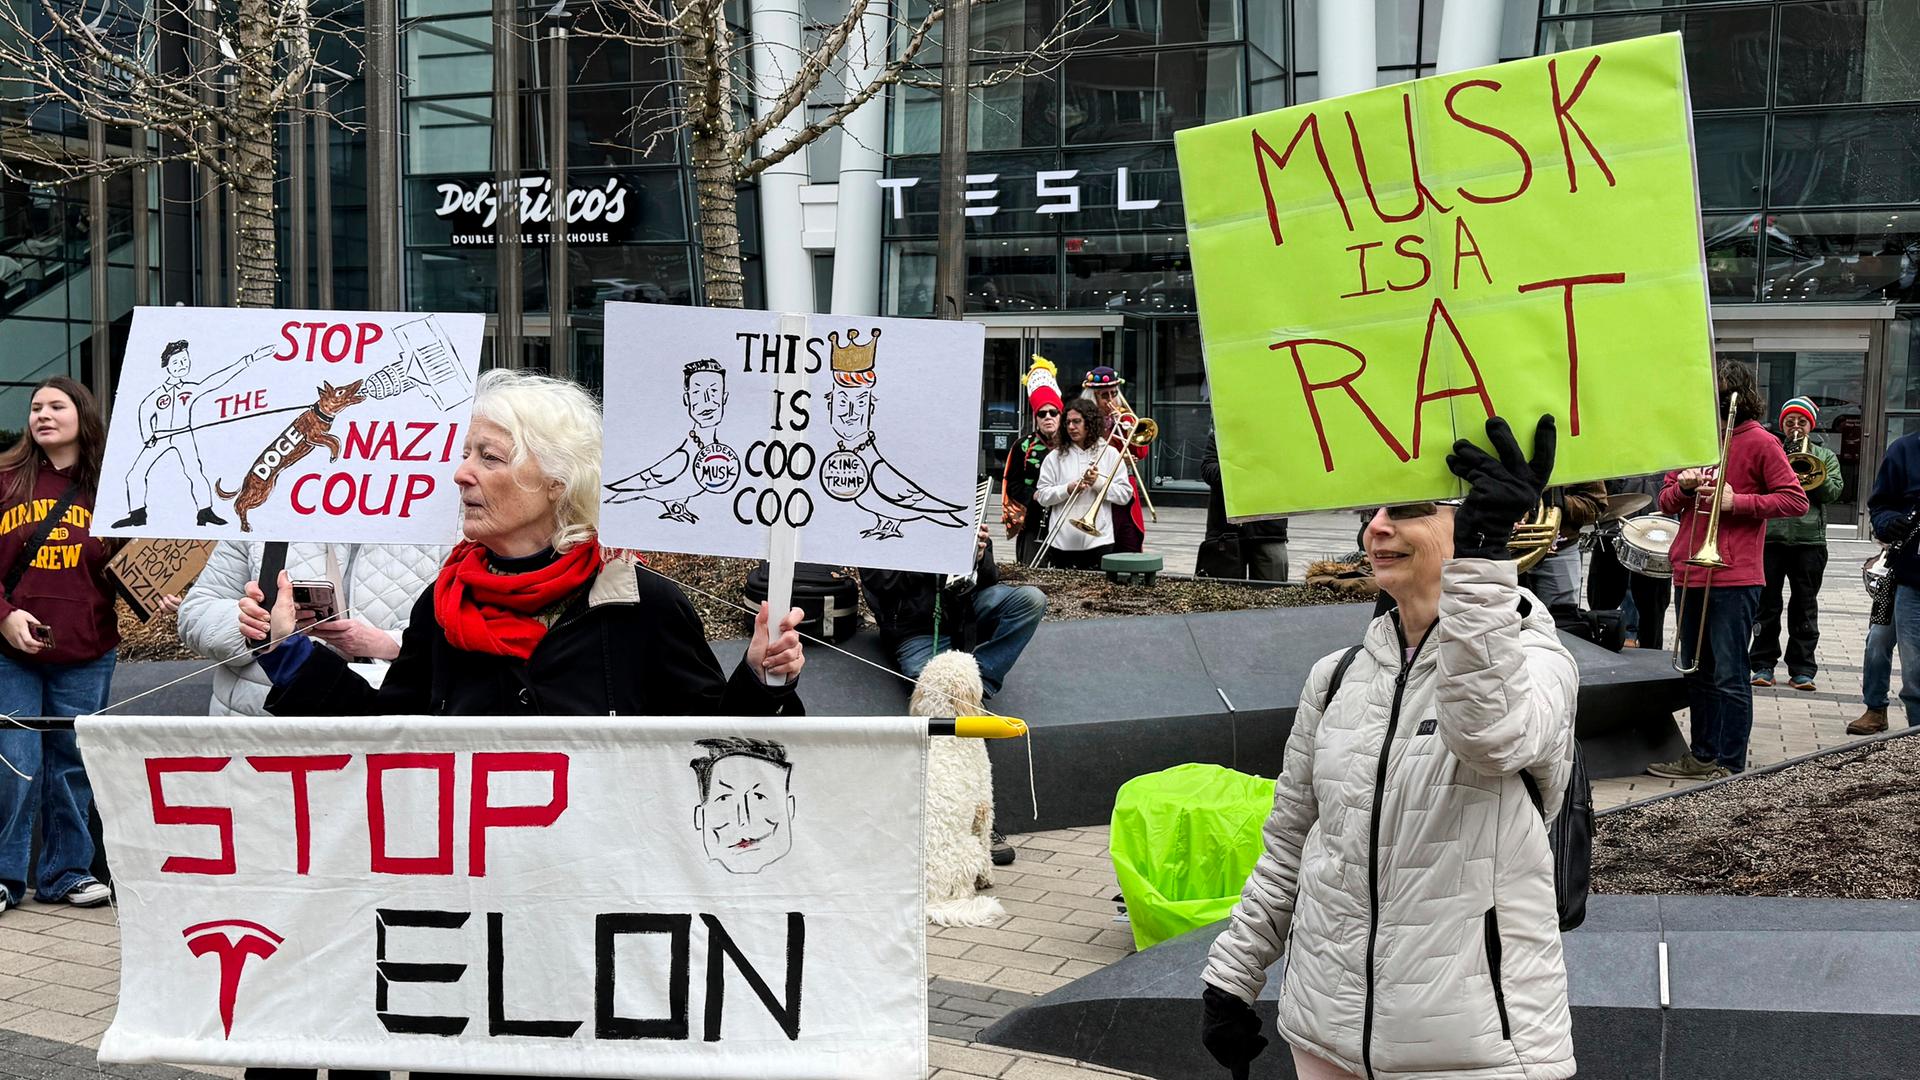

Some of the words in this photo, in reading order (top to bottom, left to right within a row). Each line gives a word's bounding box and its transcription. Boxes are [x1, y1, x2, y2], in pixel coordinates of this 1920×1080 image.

[1252, 55, 1616, 246] MUSK
[435, 181, 491, 216] Del
[452, 234, 495, 245] DOUBLE
[499, 233, 533, 245] ELE
[1340, 234, 1431, 298] IS
[1453, 216, 1493, 289] A
[273, 320, 384, 364] STOP
[736, 332, 825, 374] THIS
[1268, 272, 1626, 472] RAT
[214, 389, 268, 418] THE
[770, 389, 812, 431] IS
[253, 425, 305, 481] DOGE
[343, 420, 458, 463] NAZI
[695, 444, 738, 469] PRESIDENT
[744, 439, 816, 481] COO
[700, 465, 736, 482] MUSK
[825, 475, 865, 488] TRUMP
[827, 458, 860, 471] KING
[290, 471, 436, 518] COUP
[733, 486, 815, 528] COO
[30, 543, 83, 570] REW
[136, 545, 175, 589] FROM
[145, 751, 571, 877] STOP
[376, 907, 806, 1042] ELON
